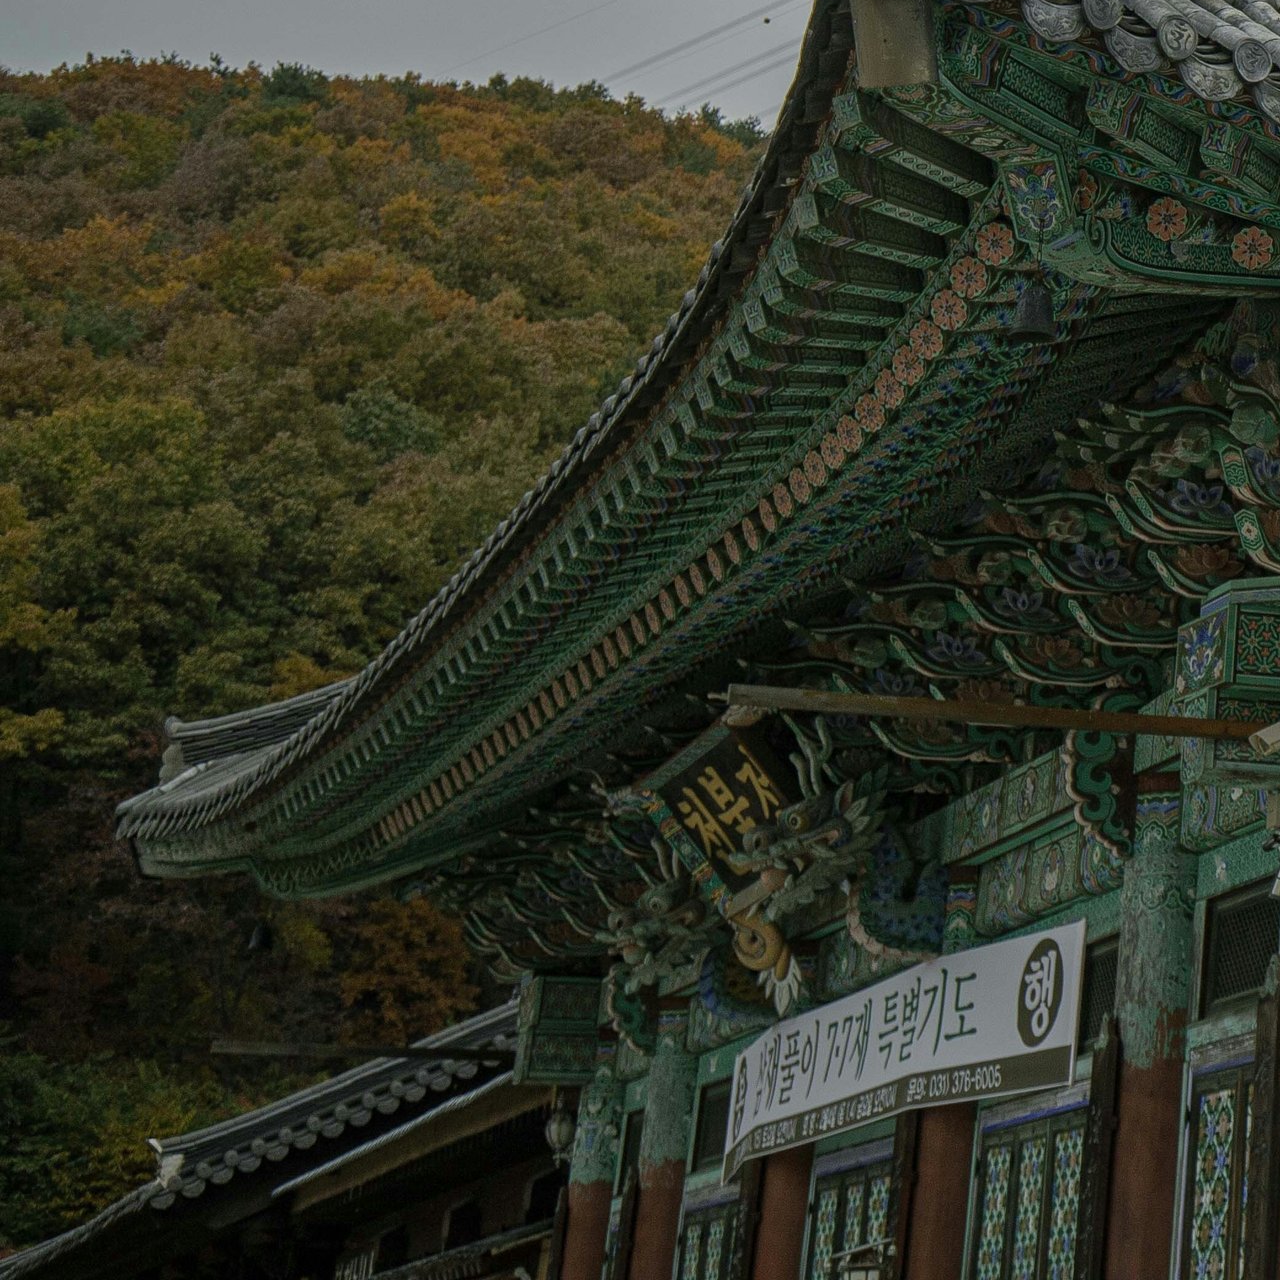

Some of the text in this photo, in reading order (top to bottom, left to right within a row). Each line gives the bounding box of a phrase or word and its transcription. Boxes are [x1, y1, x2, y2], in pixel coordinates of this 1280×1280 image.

[753, 1019, 819, 1115] 삼재풀이
[878, 968, 977, 1069] 특별기도
[1024, 949, 1057, 1038] 행
[929, 1073, 949, 1098] 031)
